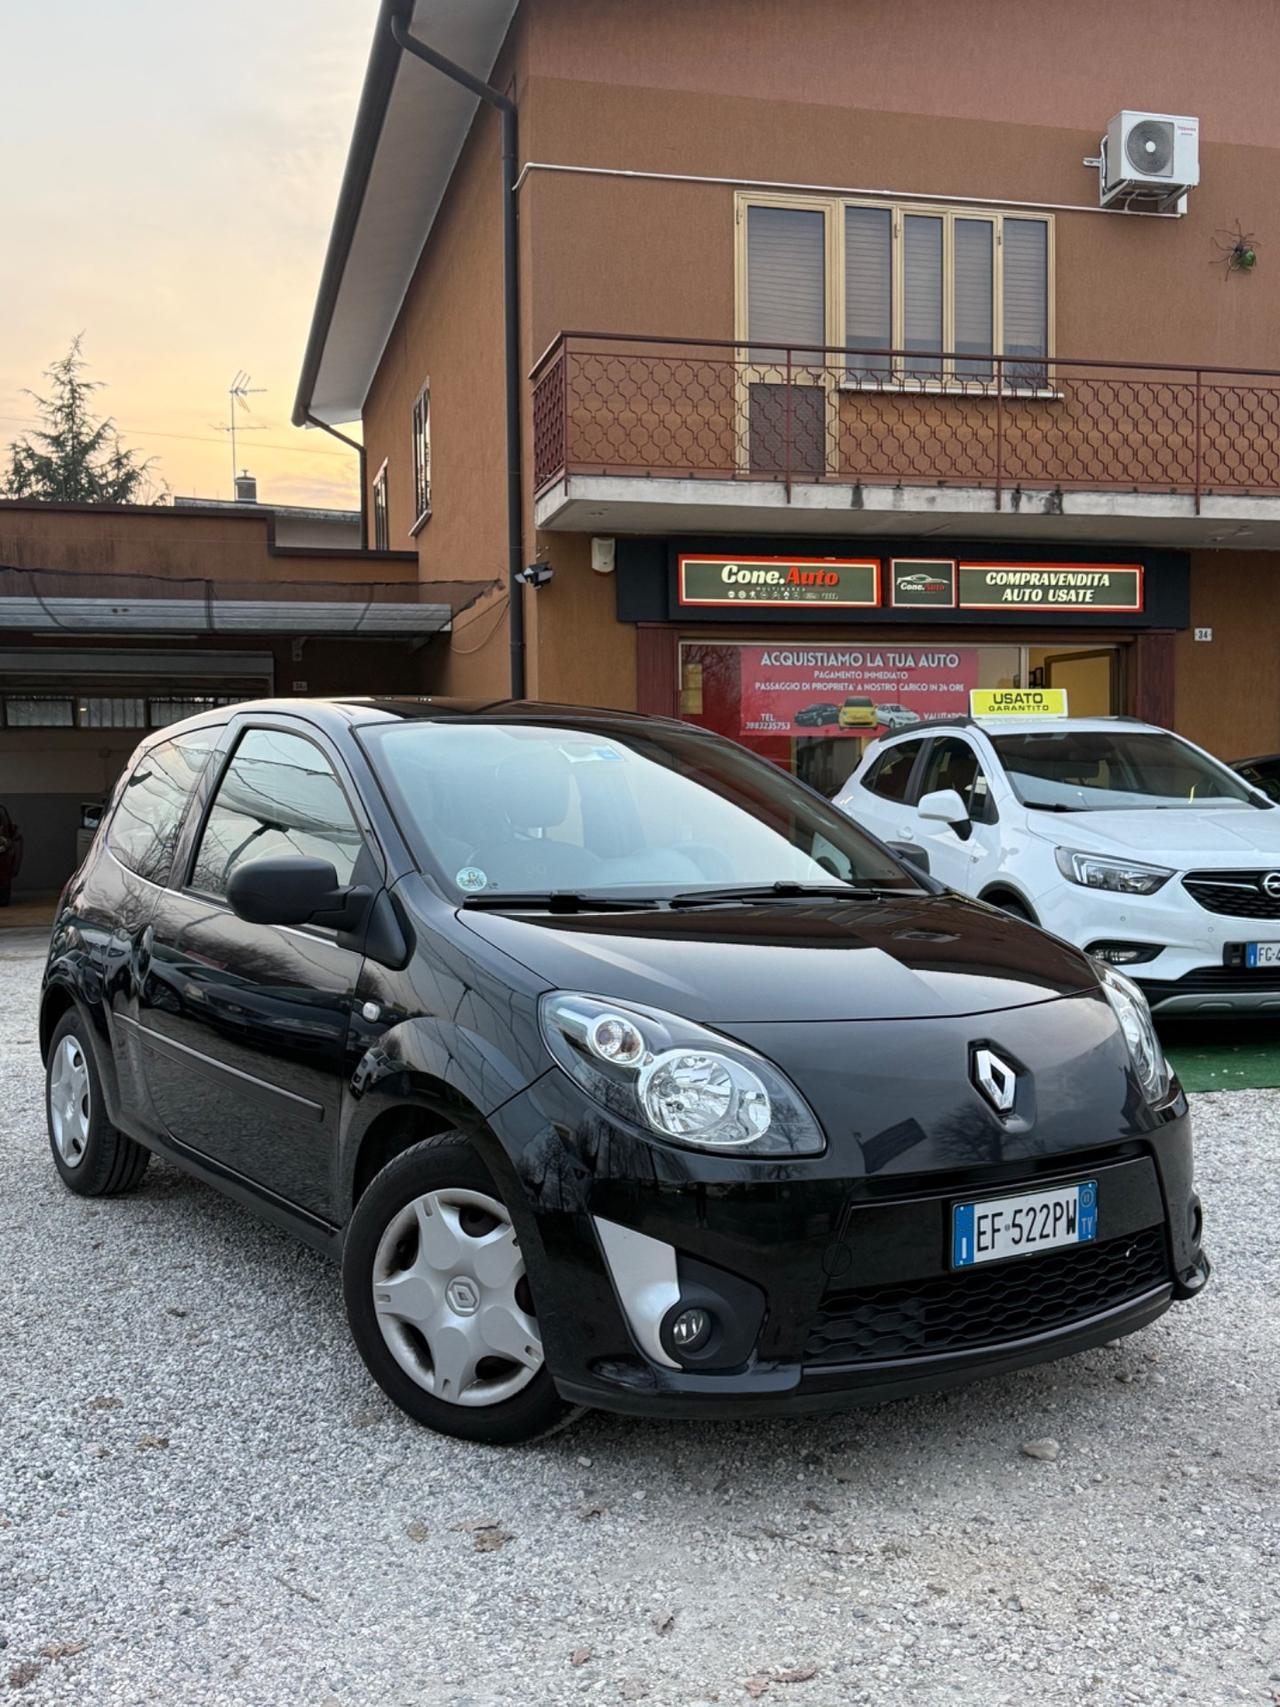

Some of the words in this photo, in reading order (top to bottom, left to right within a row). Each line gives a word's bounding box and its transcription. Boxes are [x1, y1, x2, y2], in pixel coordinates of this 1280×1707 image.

[721, 565, 839, 585] Cone.Auto
[985, 572, 1110, 586] COMPRAVENDITA
[900, 582, 945, 592] Cone.Auto
[1001, 588, 1043, 602] AUTO
[1047, 589, 1095, 602] USATE
[1198, 630, 1208, 639] 34
[761, 652, 863, 667] ACQUISTIAMO
[867, 653, 884, 667] LA
[887, 653, 915, 667] TUA
[918, 654, 959, 668] AUTO
[814, 671, 862, 679] PAGAMENTO
[864, 671, 909, 680] IMMEDIATO
[755, 682, 800, 691] PASSAGGIO
[801, 683, 810, 691] DI
[856, 683, 863, 691] A
[864, 683, 897, 691] NOSTRO
[899, 683, 928, 692] CARICO
[929, 683, 938, 692] IN
[939, 683, 948, 692] 24
[949, 683, 964, 692] ORE
[993, 692, 1044, 704] USATO
[988, 704, 1049, 712] GARANTITO
